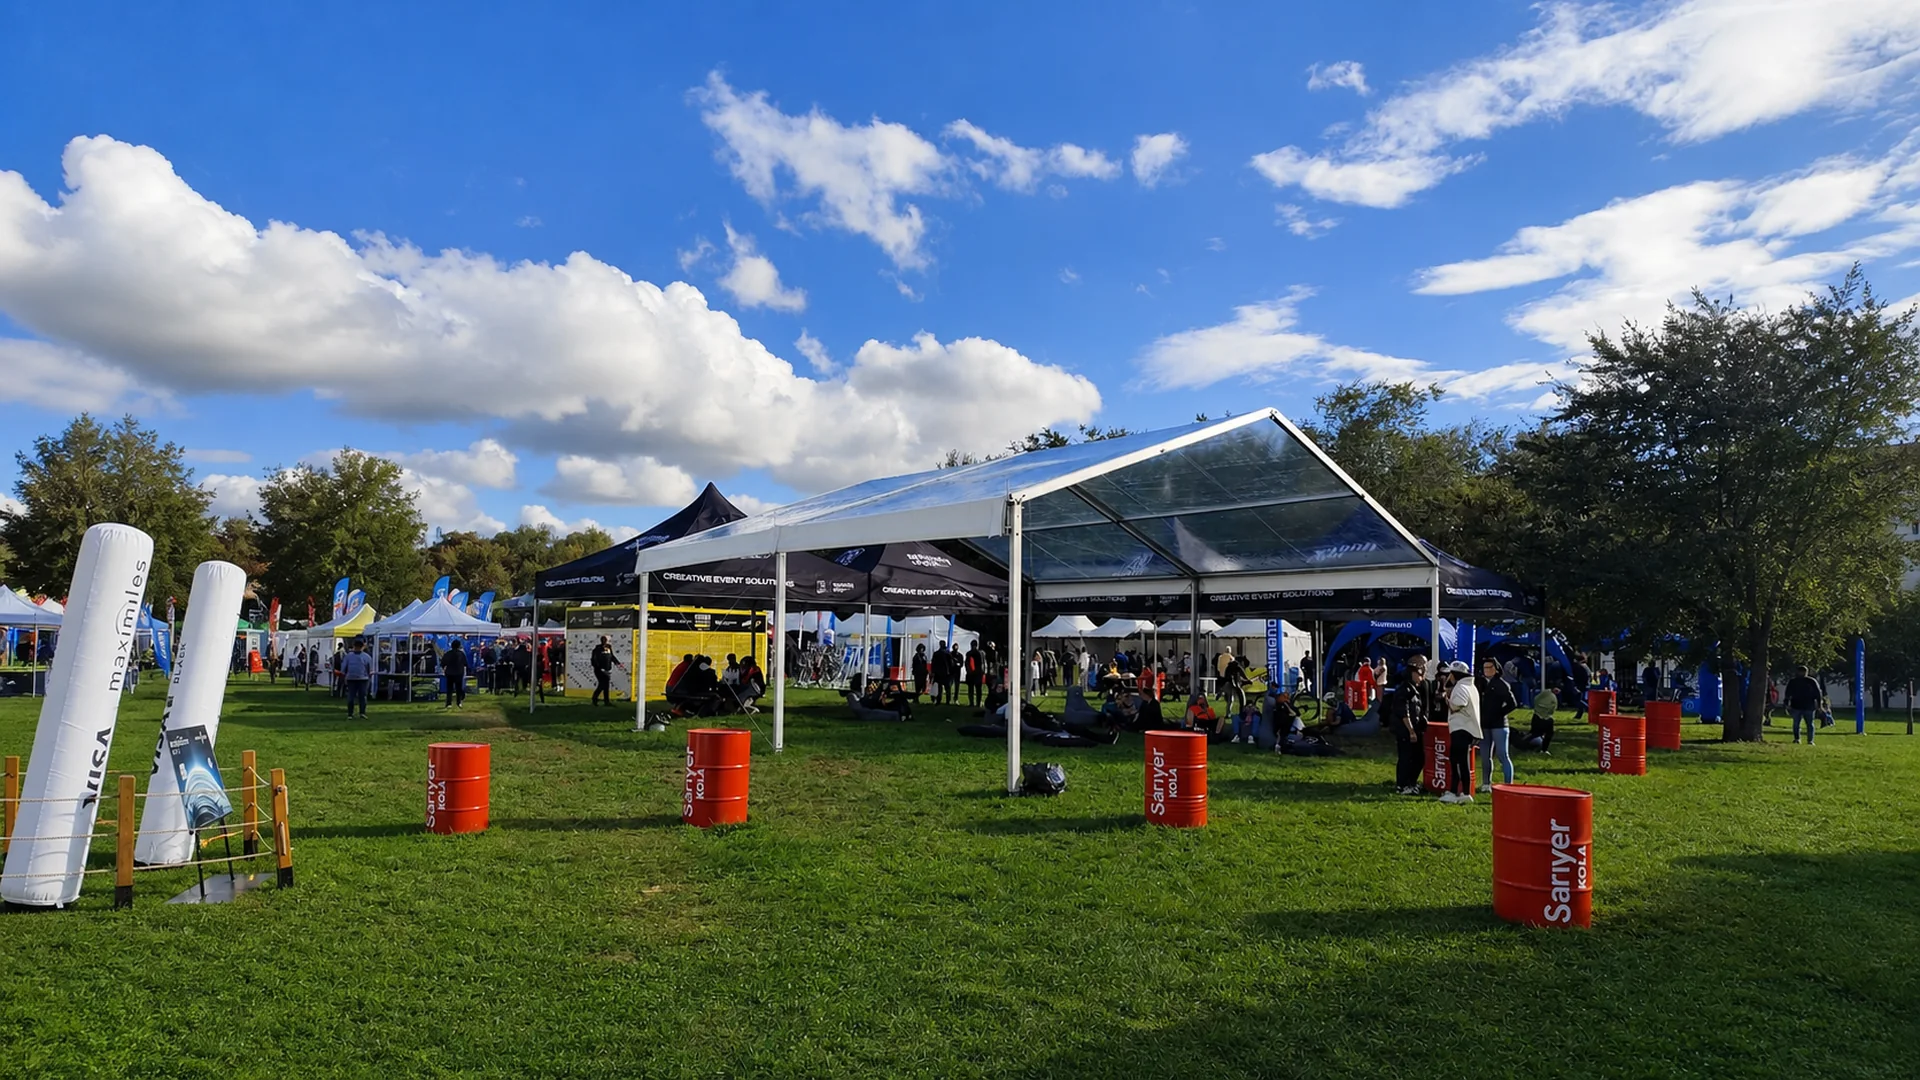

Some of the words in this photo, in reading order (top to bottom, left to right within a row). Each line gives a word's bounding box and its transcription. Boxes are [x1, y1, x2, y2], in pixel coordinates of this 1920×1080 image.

[713, 575, 744, 584] EVENT
[1251, 592, 1280, 600] EVENT
[1282, 588, 1335, 599] SOLUTIONS
[108, 559, 147, 691] maximiles
[82, 726, 112, 810] VISA
[426, 758, 439, 828] Sarıyer
[437, 780, 446, 810] KOLA
[684, 746, 698, 817] Sarıyer
[696, 768, 705, 800] KOLA
[1151, 747, 1169, 816] Sarıyer
[1168, 768, 1178, 798] KOLA
[1543, 818, 1577, 923] Sarıyer
[1577, 845, 1587, 889] KOLA
